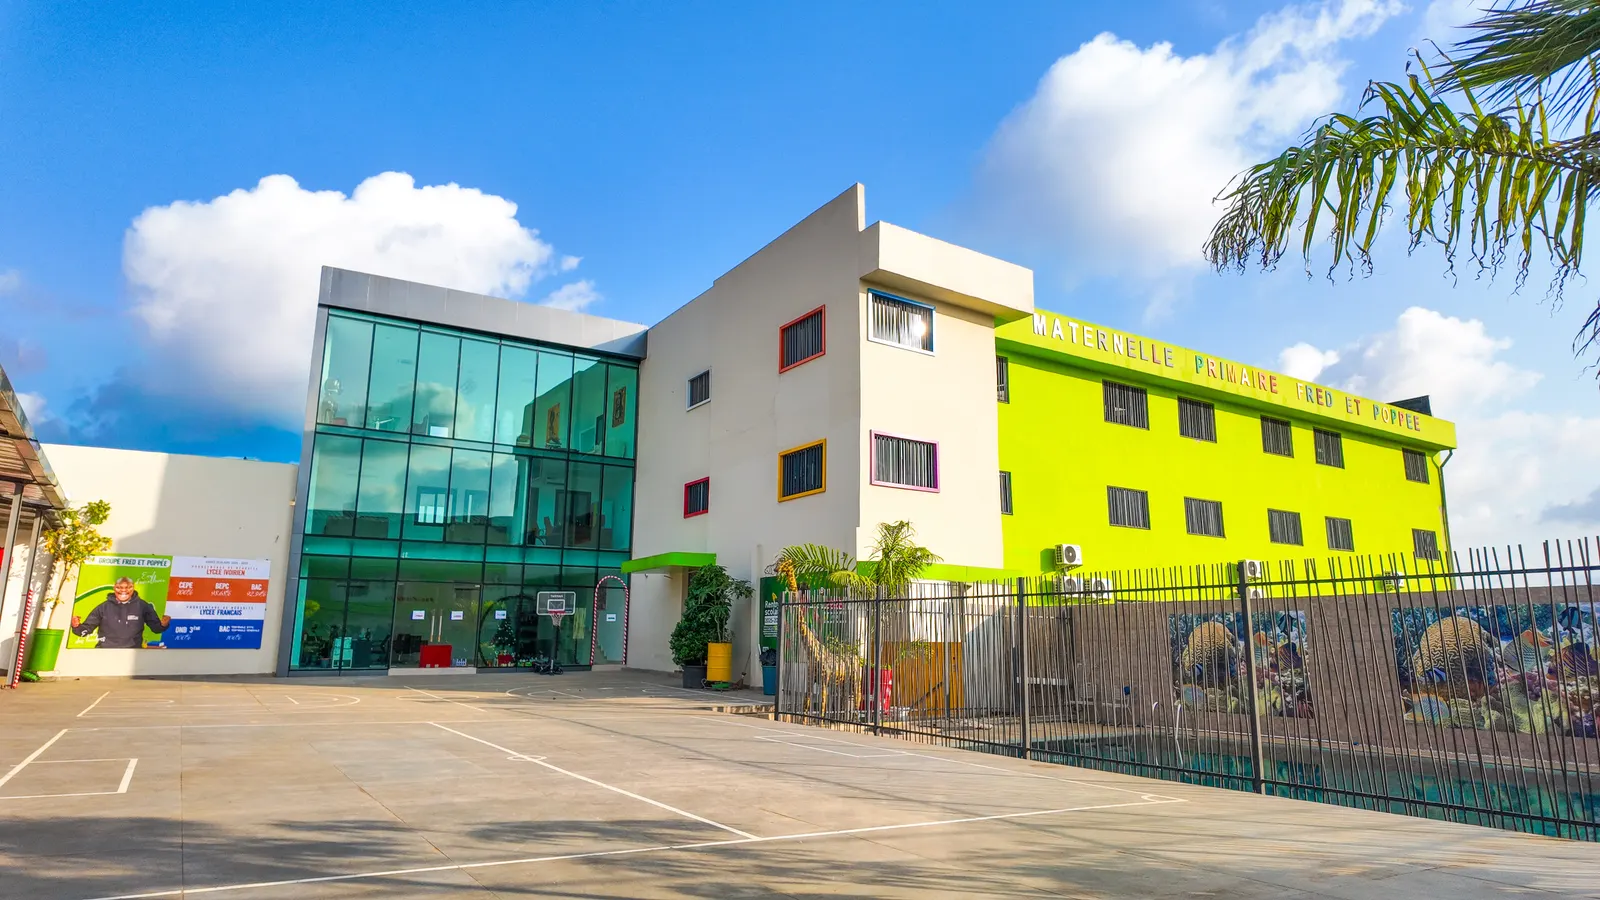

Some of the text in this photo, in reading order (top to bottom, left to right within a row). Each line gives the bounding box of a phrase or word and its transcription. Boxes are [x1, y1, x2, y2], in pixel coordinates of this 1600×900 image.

[1033, 312, 1421, 432] MATERNELLE PRIMAIRE FRED ET POPPEE
[178, 581, 193, 589] CEPE
[215, 582, 230, 590] BEPC
[251, 583, 262, 591] BAC
[219, 625, 231, 633] BAC
